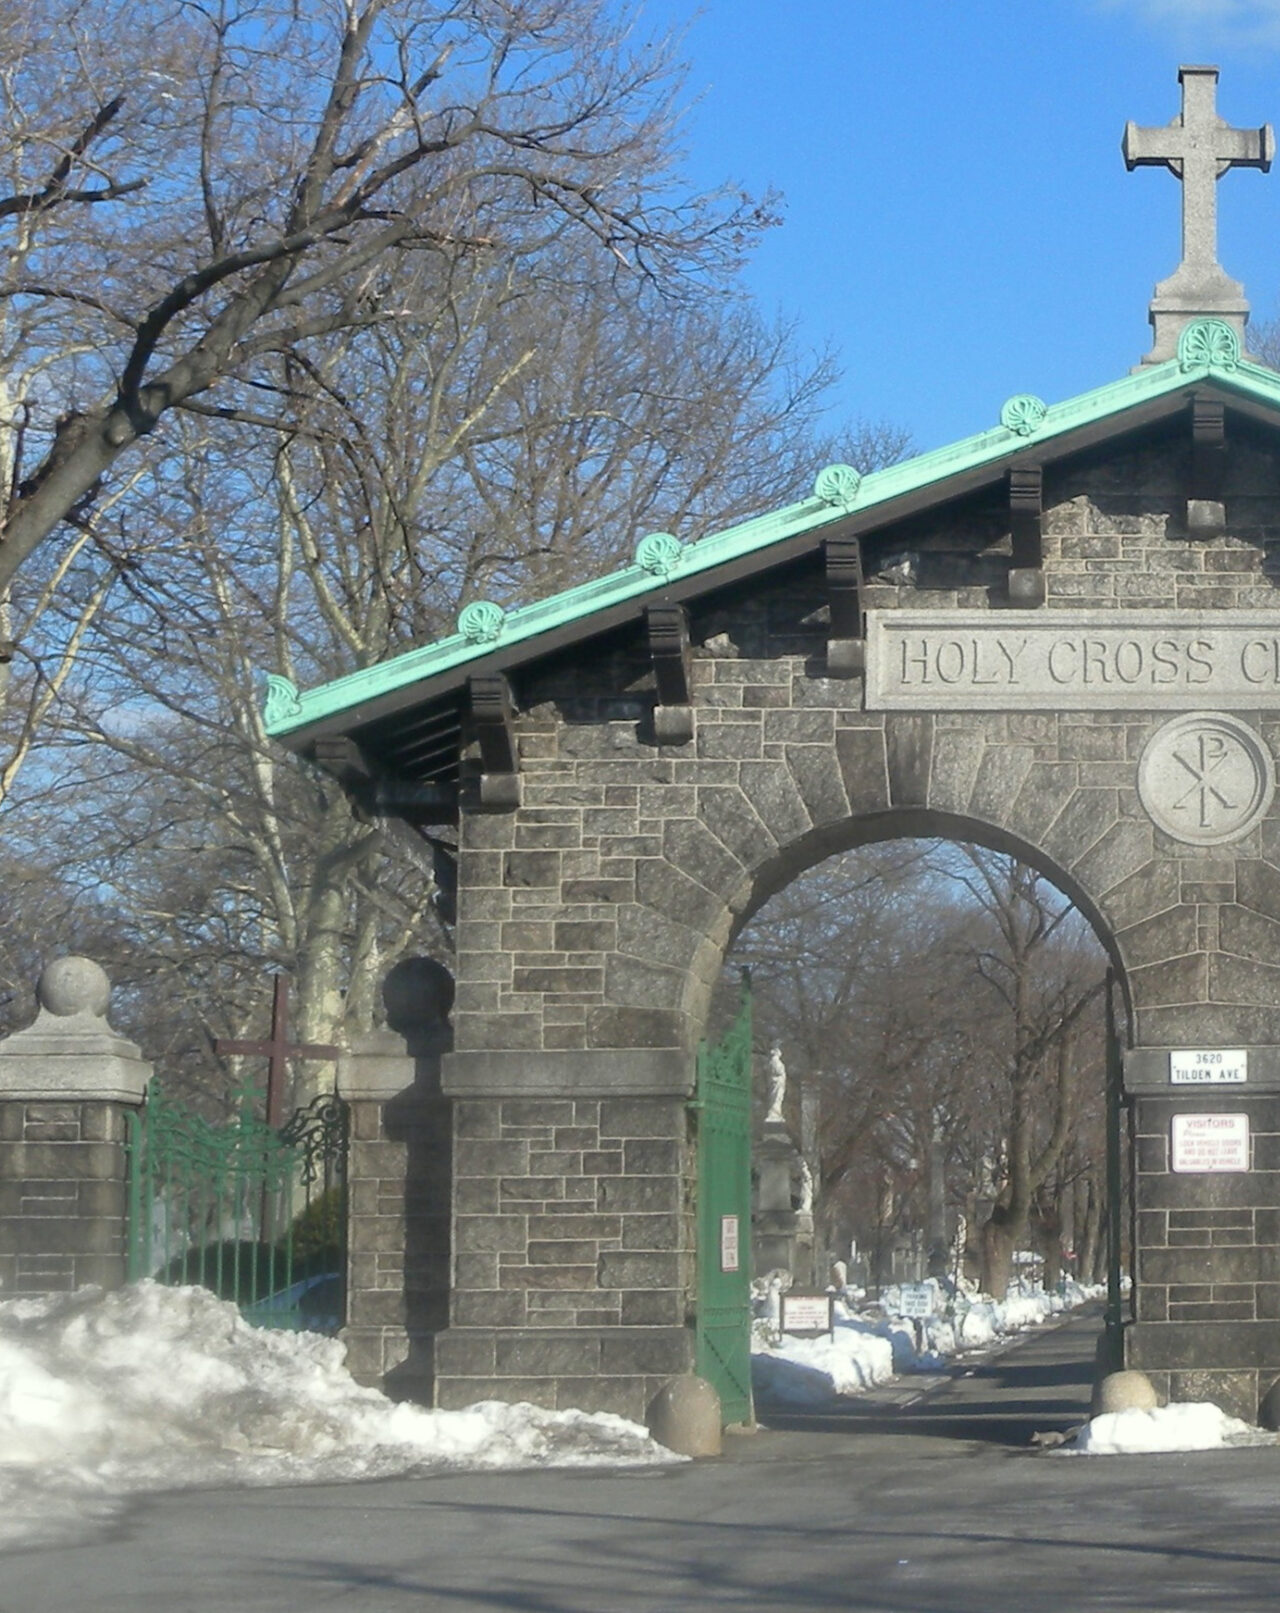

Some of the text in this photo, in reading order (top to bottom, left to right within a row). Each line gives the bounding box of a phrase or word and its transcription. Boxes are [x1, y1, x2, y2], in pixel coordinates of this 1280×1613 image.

[899, 638, 1029, 685] HOLY
[1047, 639, 1216, 685] CROSS
[1196, 1053, 1222, 1064] 3620
[1175, 1069, 1212, 1080] TILDEN
[1185, 1119, 1235, 1128] VISITORS
